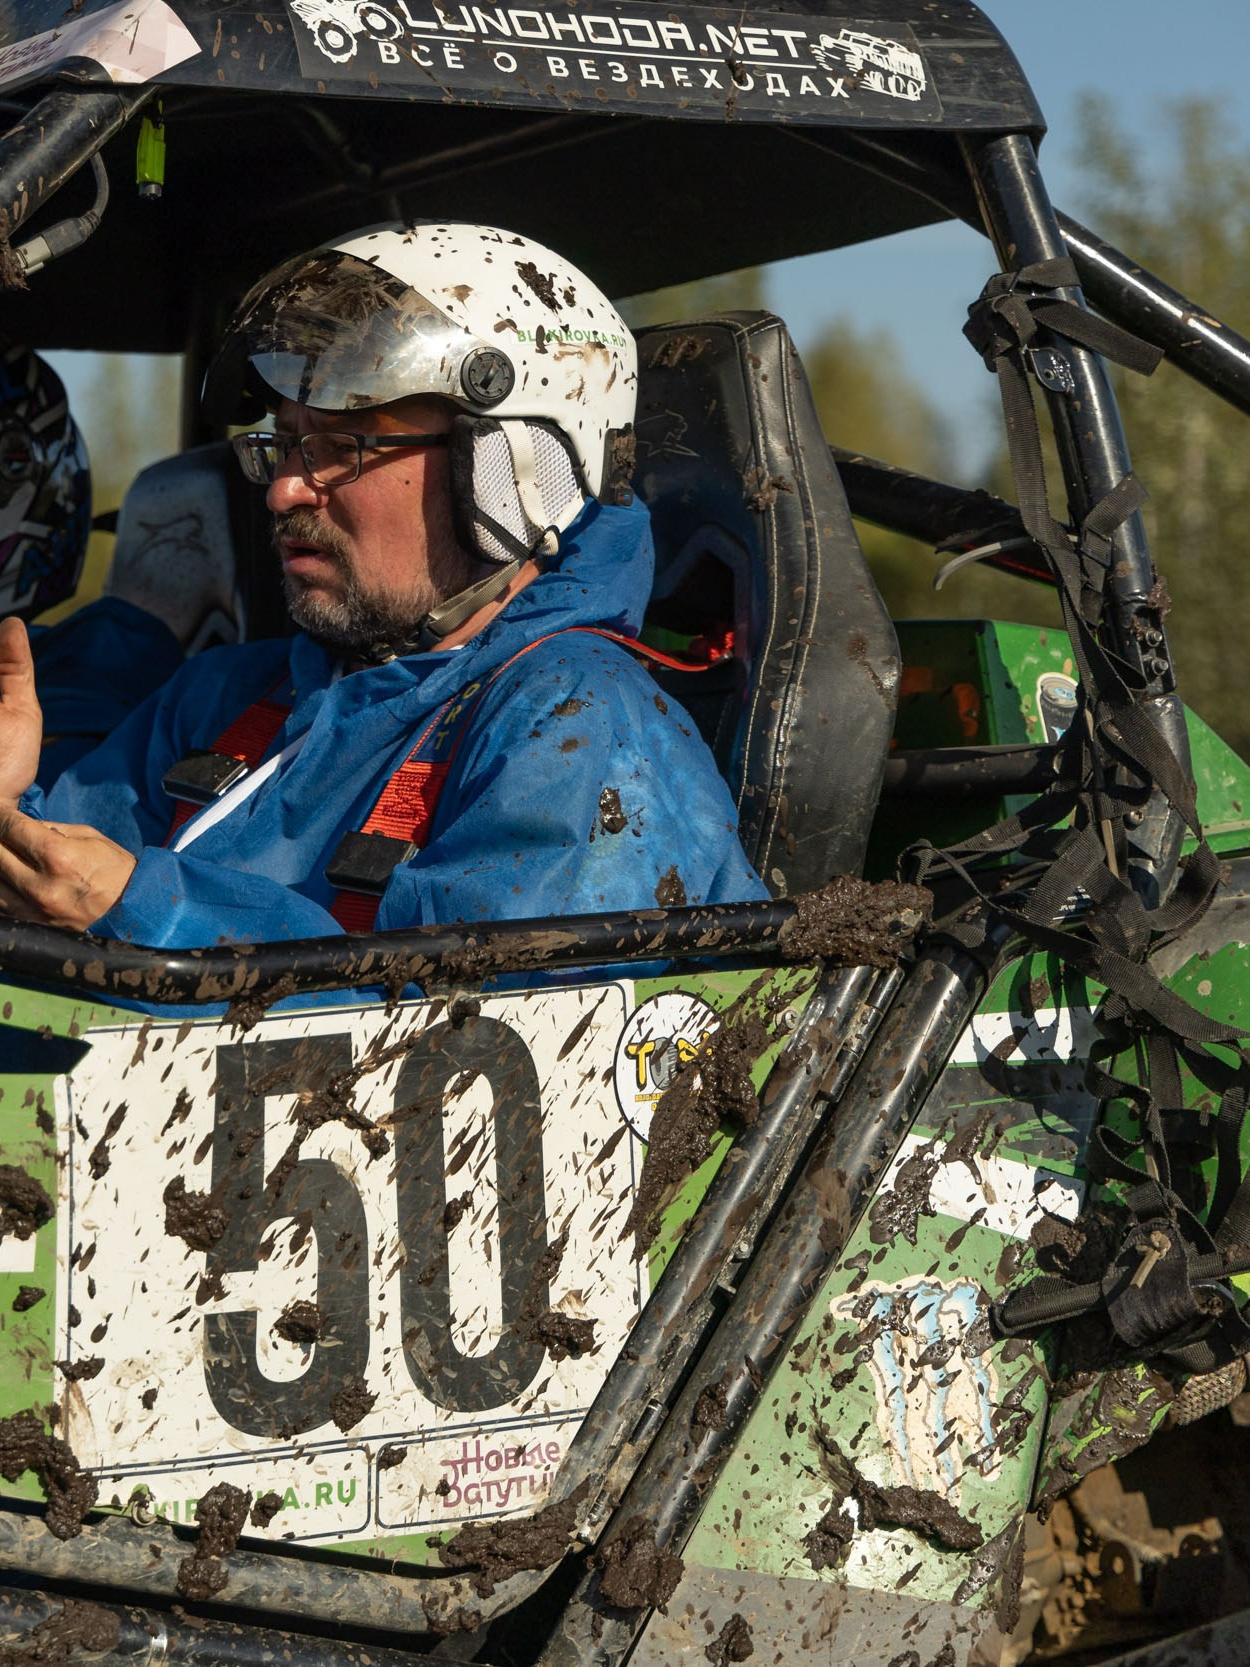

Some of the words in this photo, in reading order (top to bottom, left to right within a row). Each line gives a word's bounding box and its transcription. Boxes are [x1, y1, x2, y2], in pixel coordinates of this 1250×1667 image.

[400, 0, 808, 58] LUNOHODA.NET
[380, 42, 465, 70] ВСЁ
[517, 327, 627, 348] BLKIROVKA.RU
[203, 1015, 552, 1438] 50
